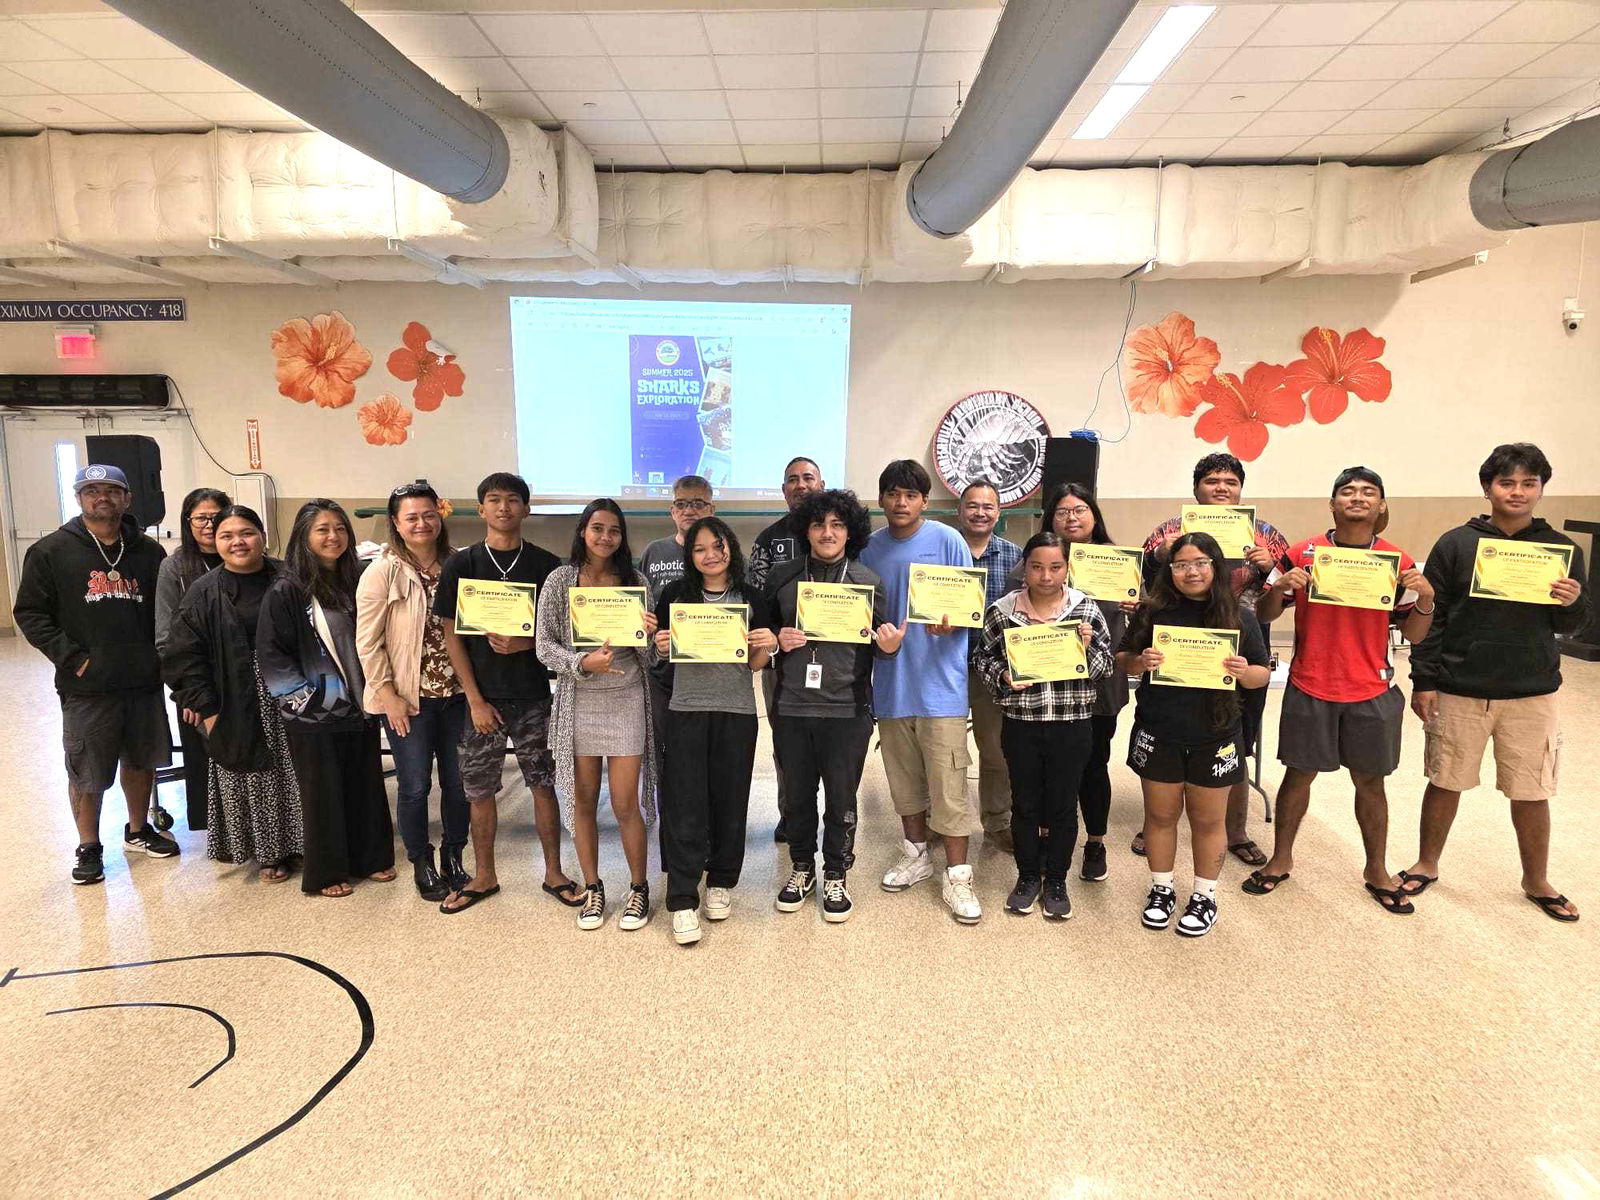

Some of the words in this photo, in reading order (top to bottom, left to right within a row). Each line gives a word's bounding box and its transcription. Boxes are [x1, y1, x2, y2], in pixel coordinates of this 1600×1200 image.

[57, 304, 152, 318] OCCUPANCY:
[158, 304, 182, 317] 418
[642, 368, 672, 377] SUMMER
[673, 368, 694, 377] 2025
[637, 378, 700, 396] SHARKS
[636, 394, 700, 406] EXPLORATION
[1498, 552, 1553, 560] CERTIFICATE
[1024, 632, 1068, 642] CERTIFICATE
